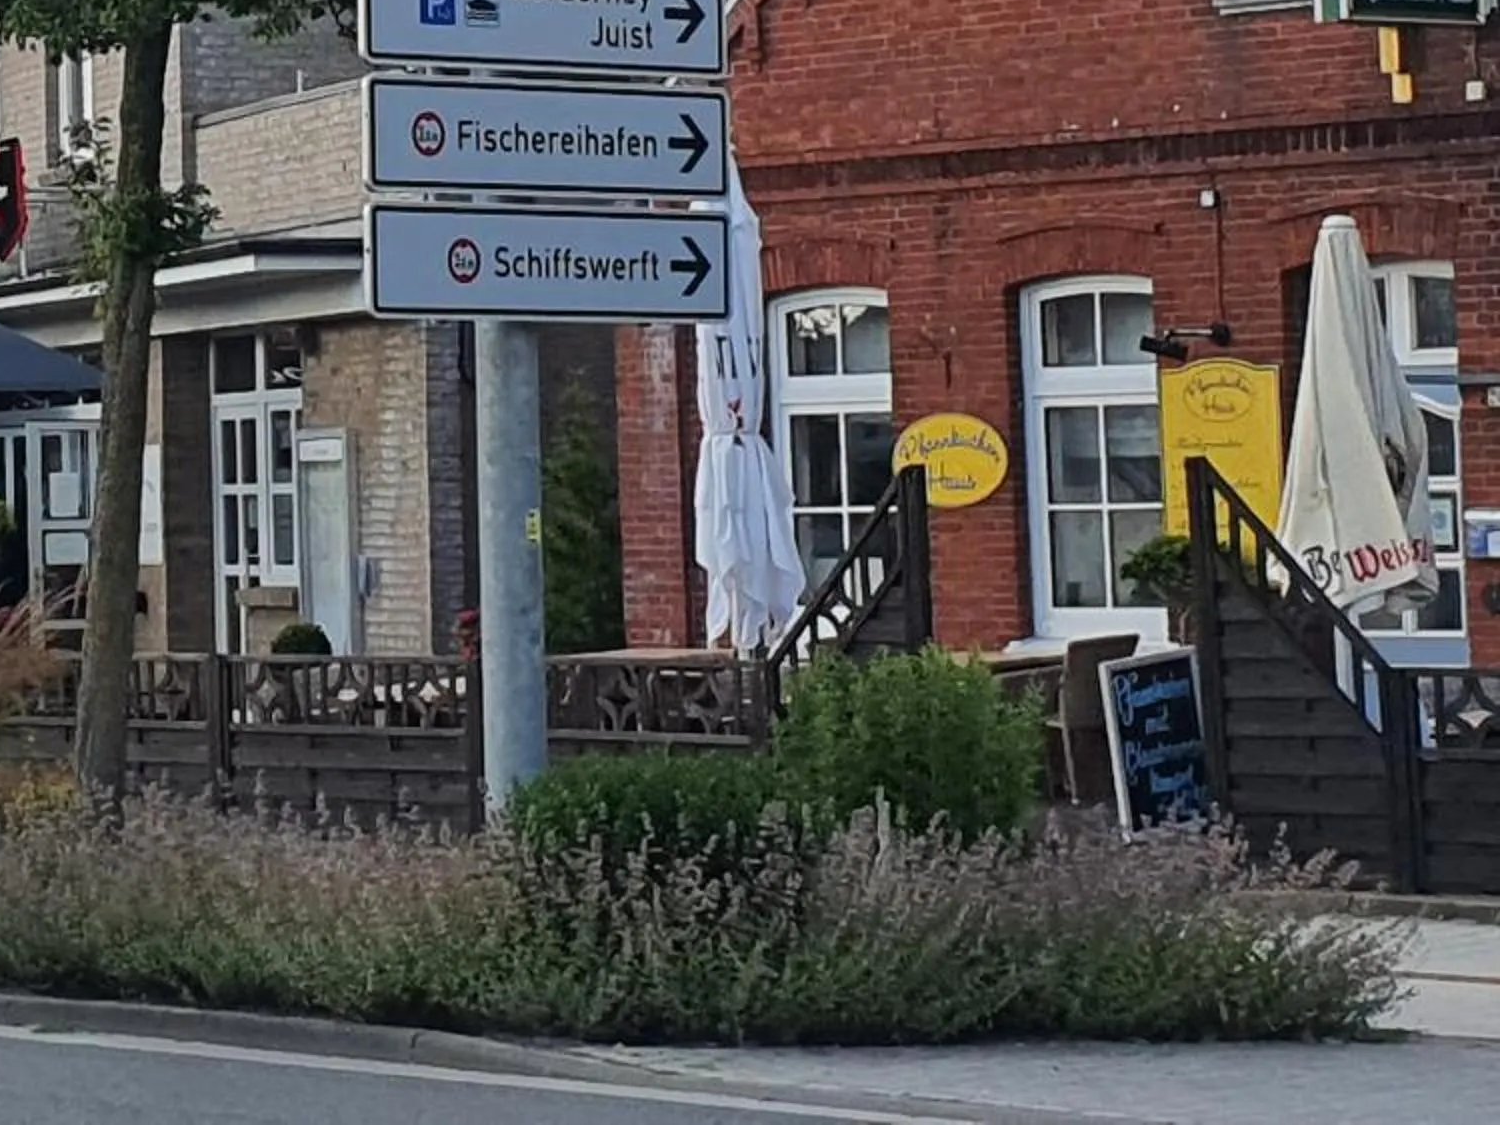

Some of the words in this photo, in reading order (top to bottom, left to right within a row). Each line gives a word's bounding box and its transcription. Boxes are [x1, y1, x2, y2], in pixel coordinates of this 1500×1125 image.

[590, 17, 654, 50] Juist
[456, 119, 659, 159] Fischereihafen
[493, 246, 660, 282] Schiffswerft
